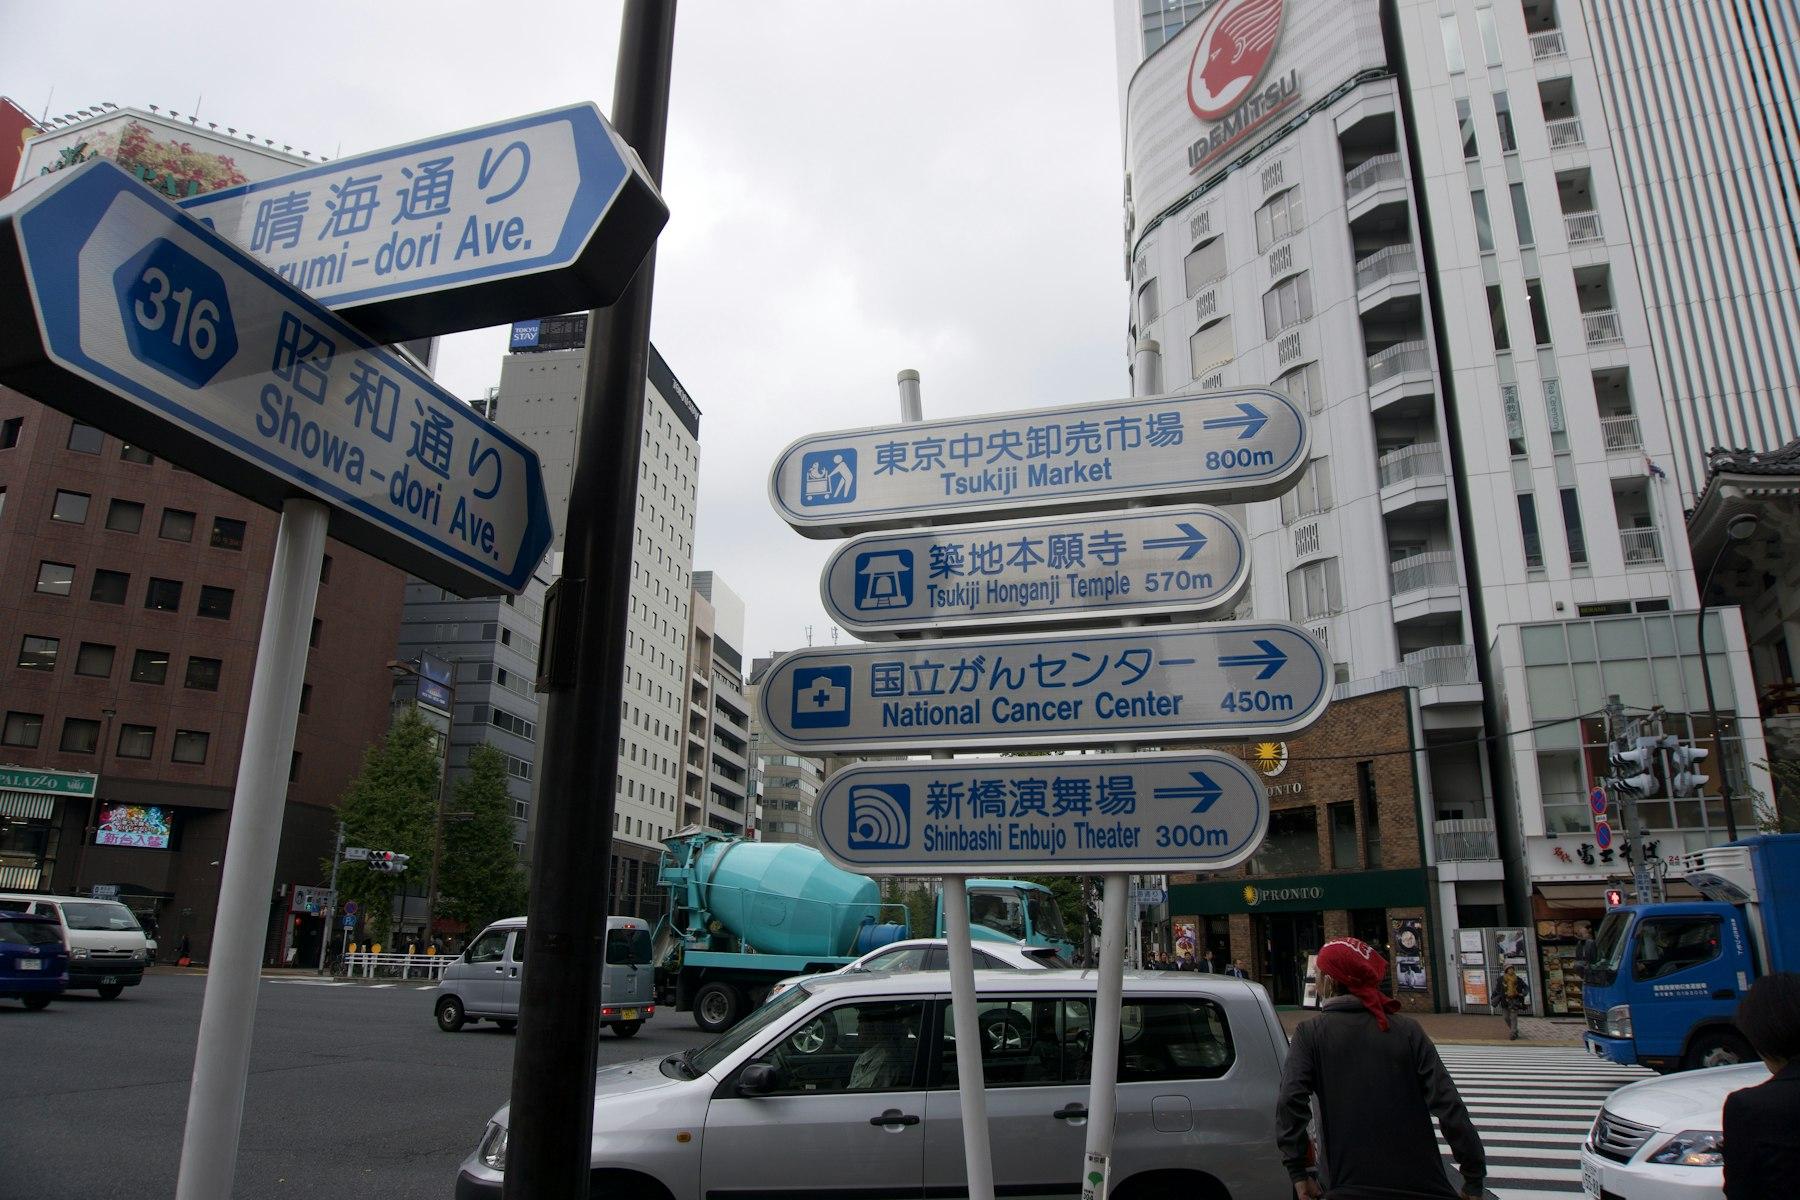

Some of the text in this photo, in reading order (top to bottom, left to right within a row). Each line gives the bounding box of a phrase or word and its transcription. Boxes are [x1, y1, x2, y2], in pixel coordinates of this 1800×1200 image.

[1188, 69, 1299, 169] IDEMITSU
[249, 140, 531, 253] 晴海通り
[455, 213, 532, 260] Ave.
[134, 265, 221, 361] 316
[513, 332, 537, 341] STAY
[272, 310, 503, 501] 昭和通り
[874, 411, 1185, 476] 東京中央卸売市場
[1205, 448, 1274, 471] 800m
[256, 383, 500, 561] Showa-dori Ave.
[940, 457, 1113, 497] Tsukiji Market
[927, 530, 1127, 579] 築地本願寺
[926, 569, 1213, 609] Tsukiji Honganji Temple 570m
[871, 646, 1196, 698] 国立がんセンター
[882, 690, 1294, 728] National Cancer Center 450m
[0, 774, 58, 789] PALAZZO
[926, 776, 1137, 819] 新橋演舞場
[1267, 782, 1302, 798] ONTO
[923, 821, 1229, 853] Shinbashi Enbujo Theater 300m
[1262, 886, 1322, 902] PRONTO
